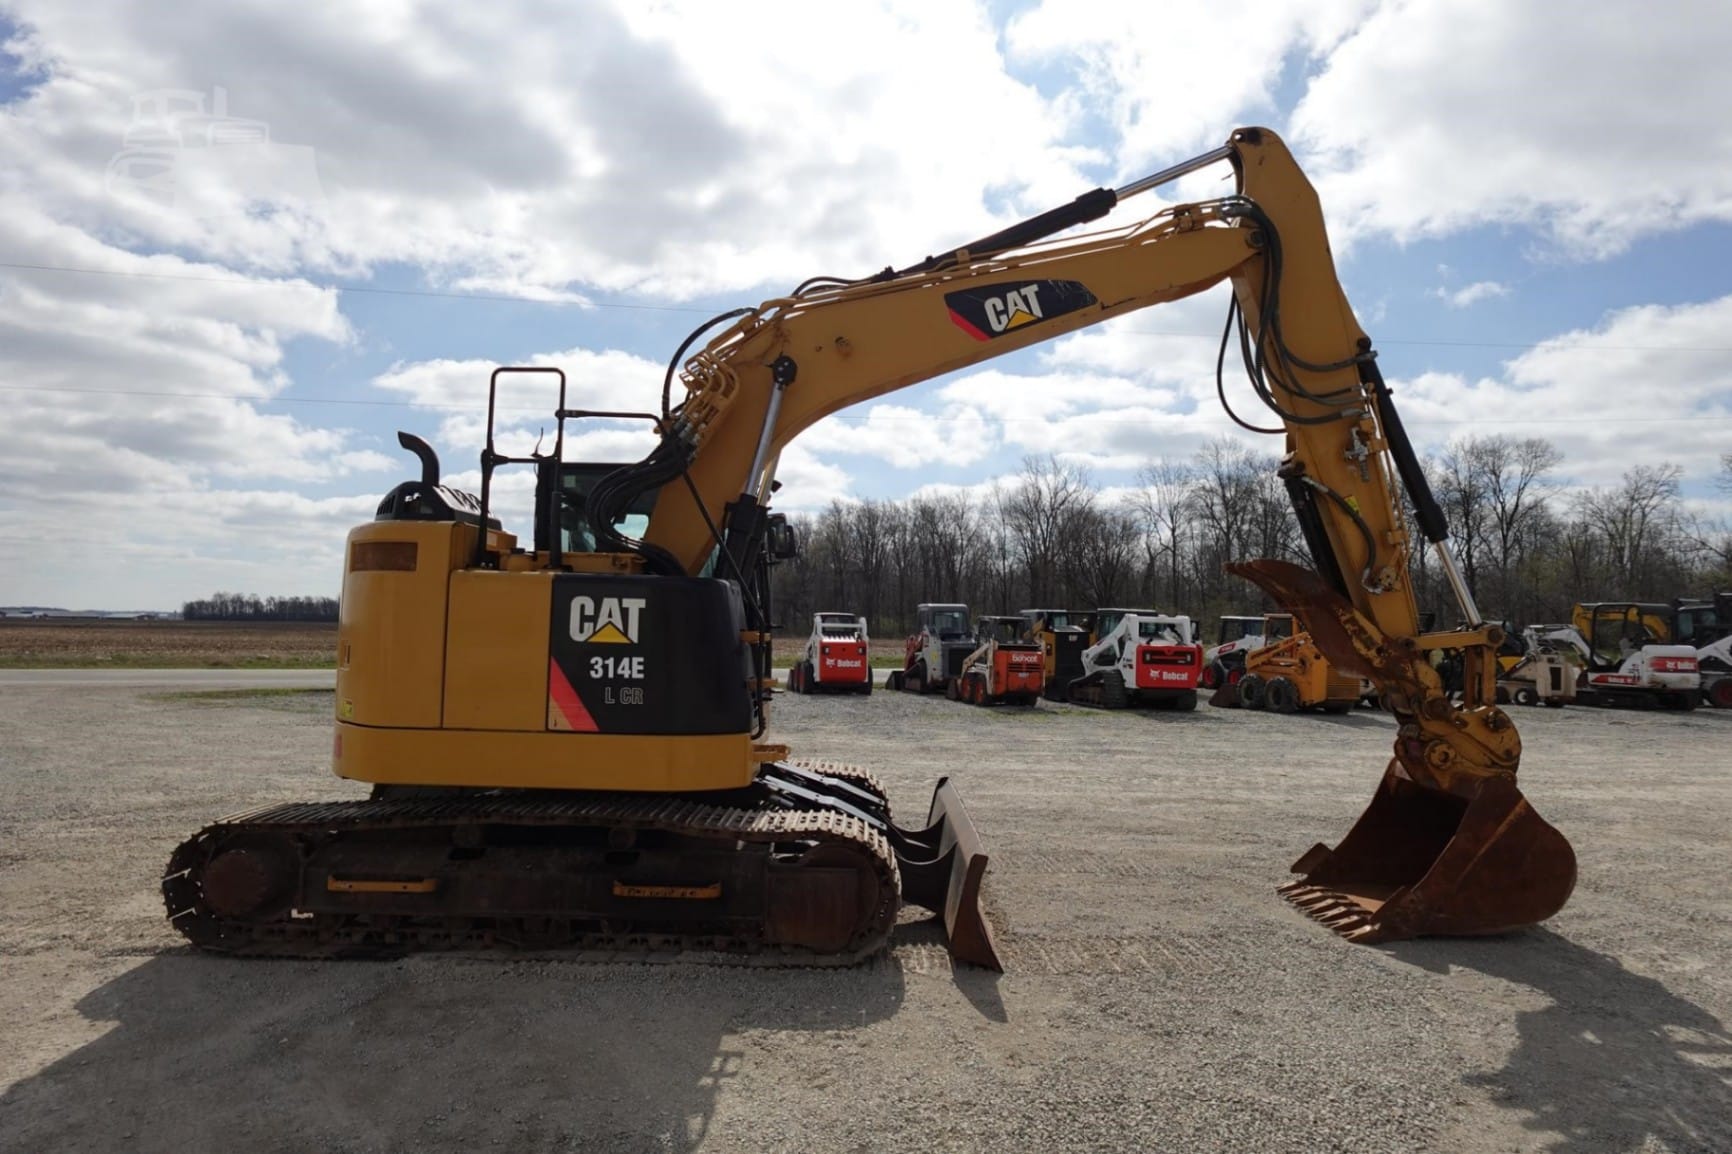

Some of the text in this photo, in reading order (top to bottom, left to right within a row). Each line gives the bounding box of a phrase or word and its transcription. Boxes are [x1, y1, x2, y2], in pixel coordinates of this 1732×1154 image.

[984, 284, 1043, 332] CAT
[569, 595, 646, 644] CAT
[589, 656, 645, 679] 314E
[837, 659, 862, 668] Bobcat
[1162, 671, 1189, 681] Bobcat
[604, 686, 644, 705] L CR
